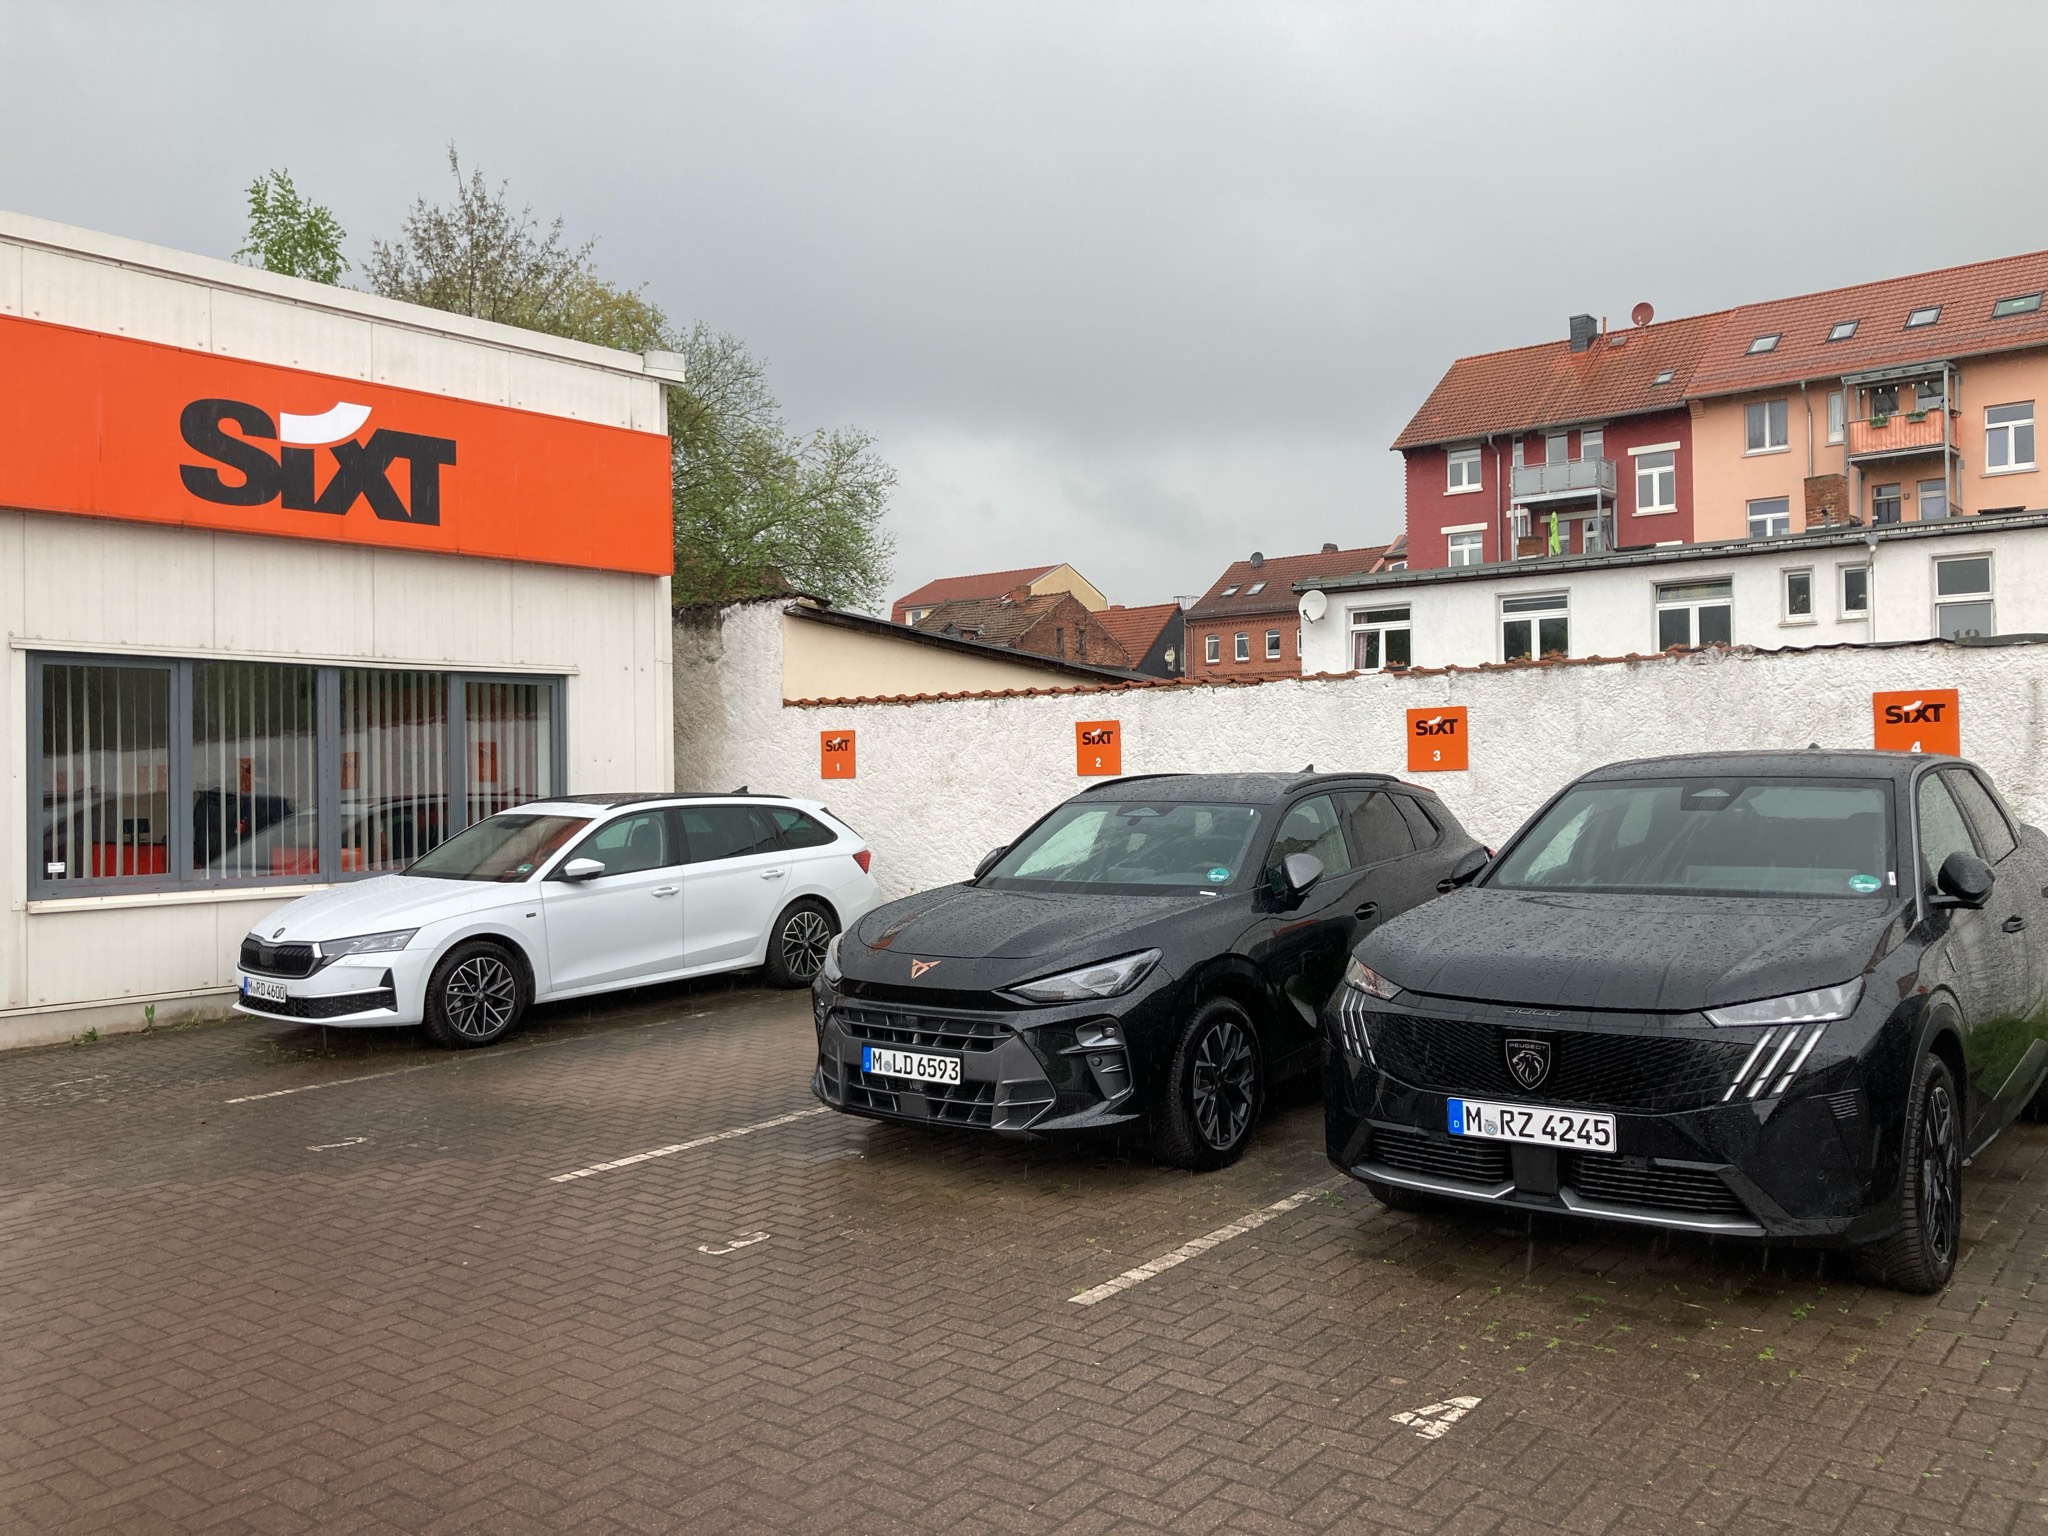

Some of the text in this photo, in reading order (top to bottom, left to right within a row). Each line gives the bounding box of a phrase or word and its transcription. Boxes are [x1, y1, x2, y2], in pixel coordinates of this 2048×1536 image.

[1911, 741, 1922, 753] 4
[1433, 750, 1441, 762] 3
[1095, 757, 1102, 768] 2
[1508, 1042, 1547, 1051] PEUGEOT
[872, 1050, 959, 1081] M LD 6593
[1453, 1119, 1460, 1128] D
[1465, 1105, 1611, 1147] M RZ 4245
